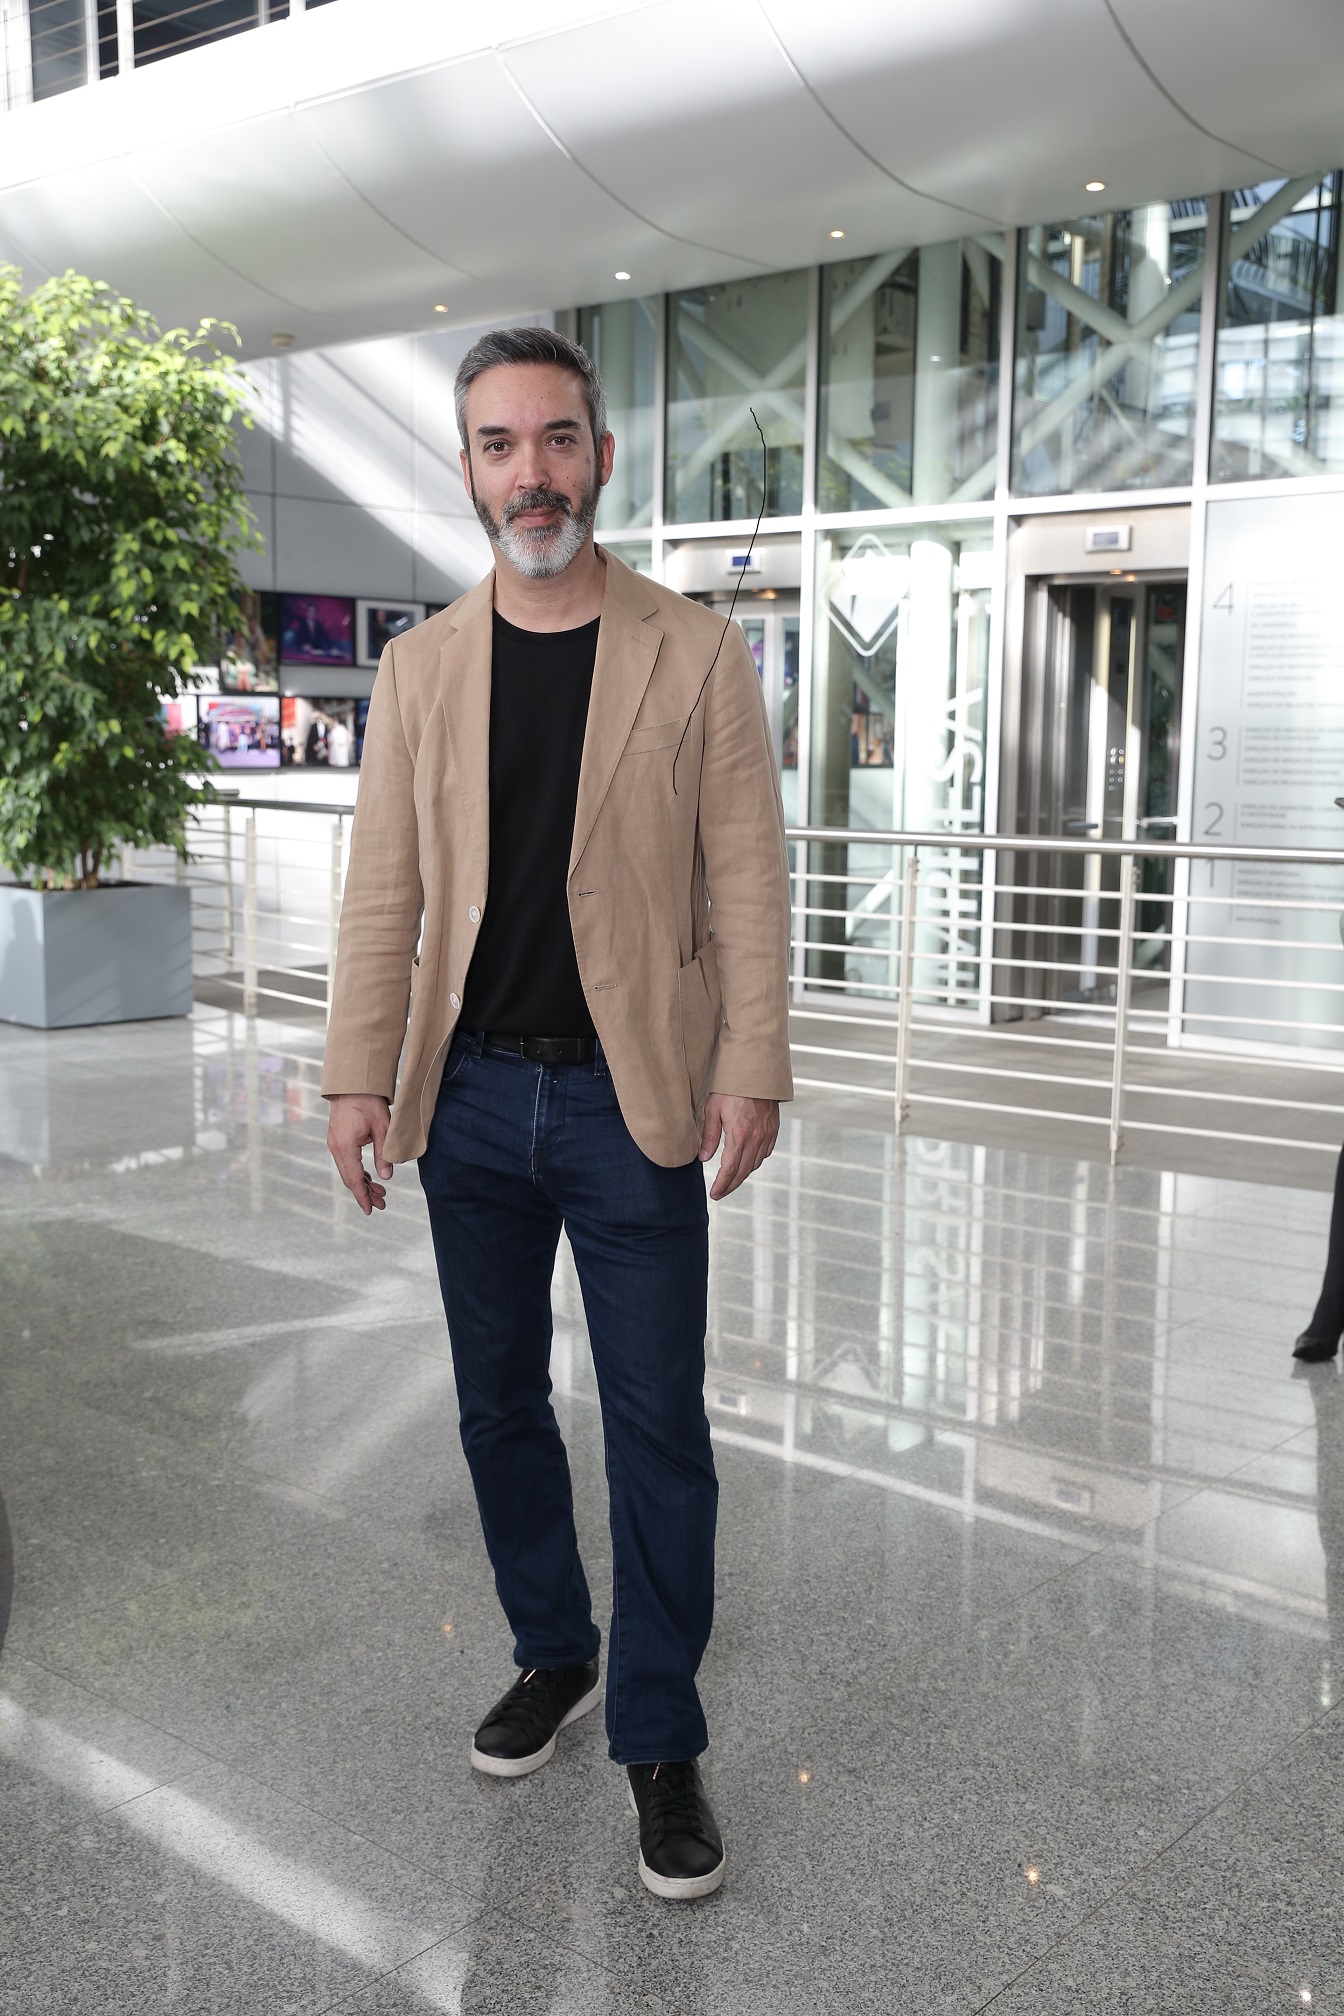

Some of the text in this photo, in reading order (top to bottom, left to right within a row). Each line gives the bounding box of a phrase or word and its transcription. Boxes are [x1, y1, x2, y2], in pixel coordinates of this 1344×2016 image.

[1212, 582, 1235, 615] 4
[1206, 726, 1228, 761] 3
[1203, 802, 1224, 836] 2
[923, 687, 983, 995] IMPRESA
